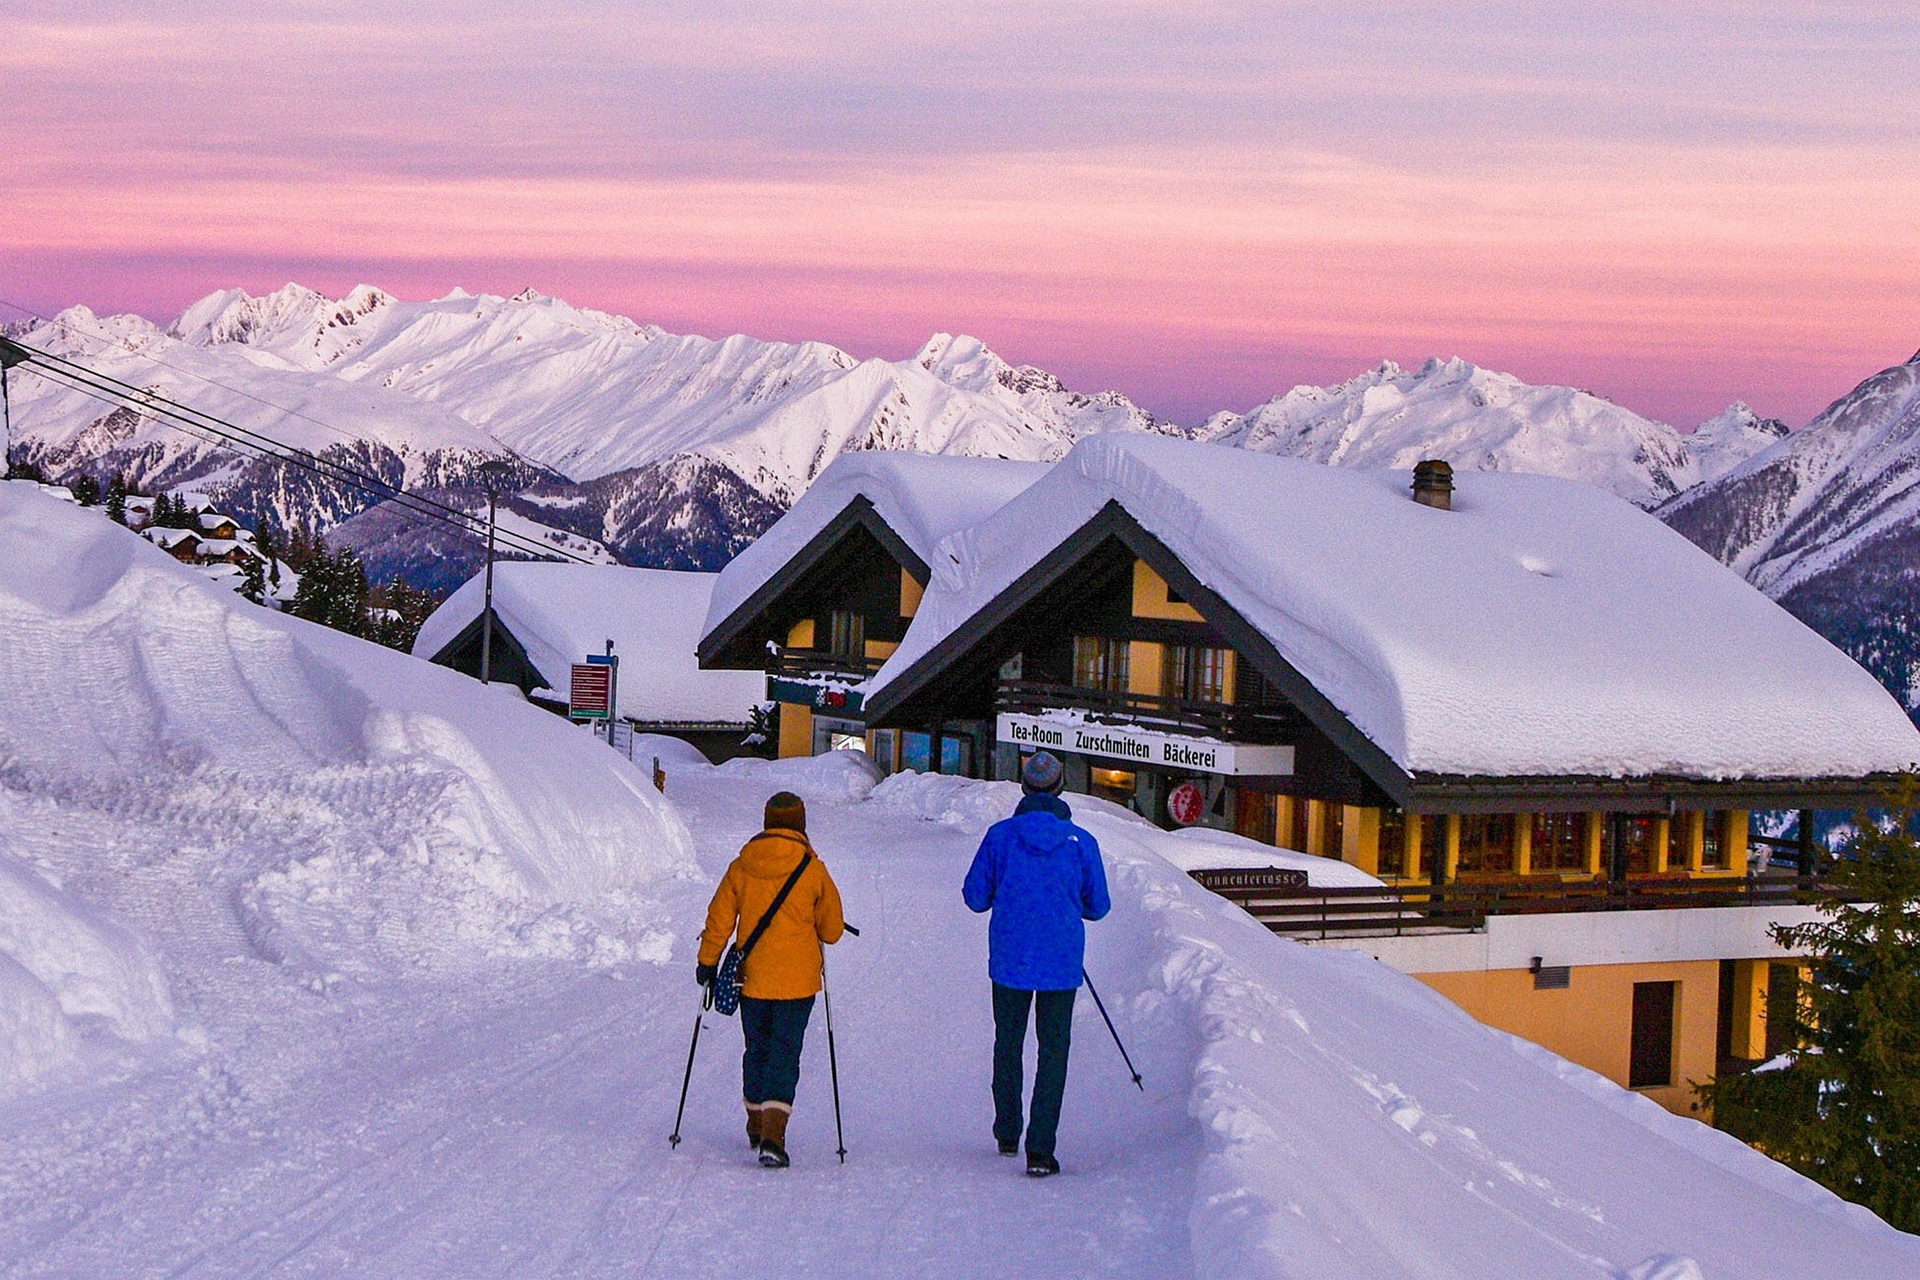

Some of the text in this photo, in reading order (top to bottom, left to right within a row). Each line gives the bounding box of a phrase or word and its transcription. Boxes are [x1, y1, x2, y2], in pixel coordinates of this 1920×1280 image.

[1010, 722, 1216, 768] Tea-Room Zurschmitten Bäckerei
